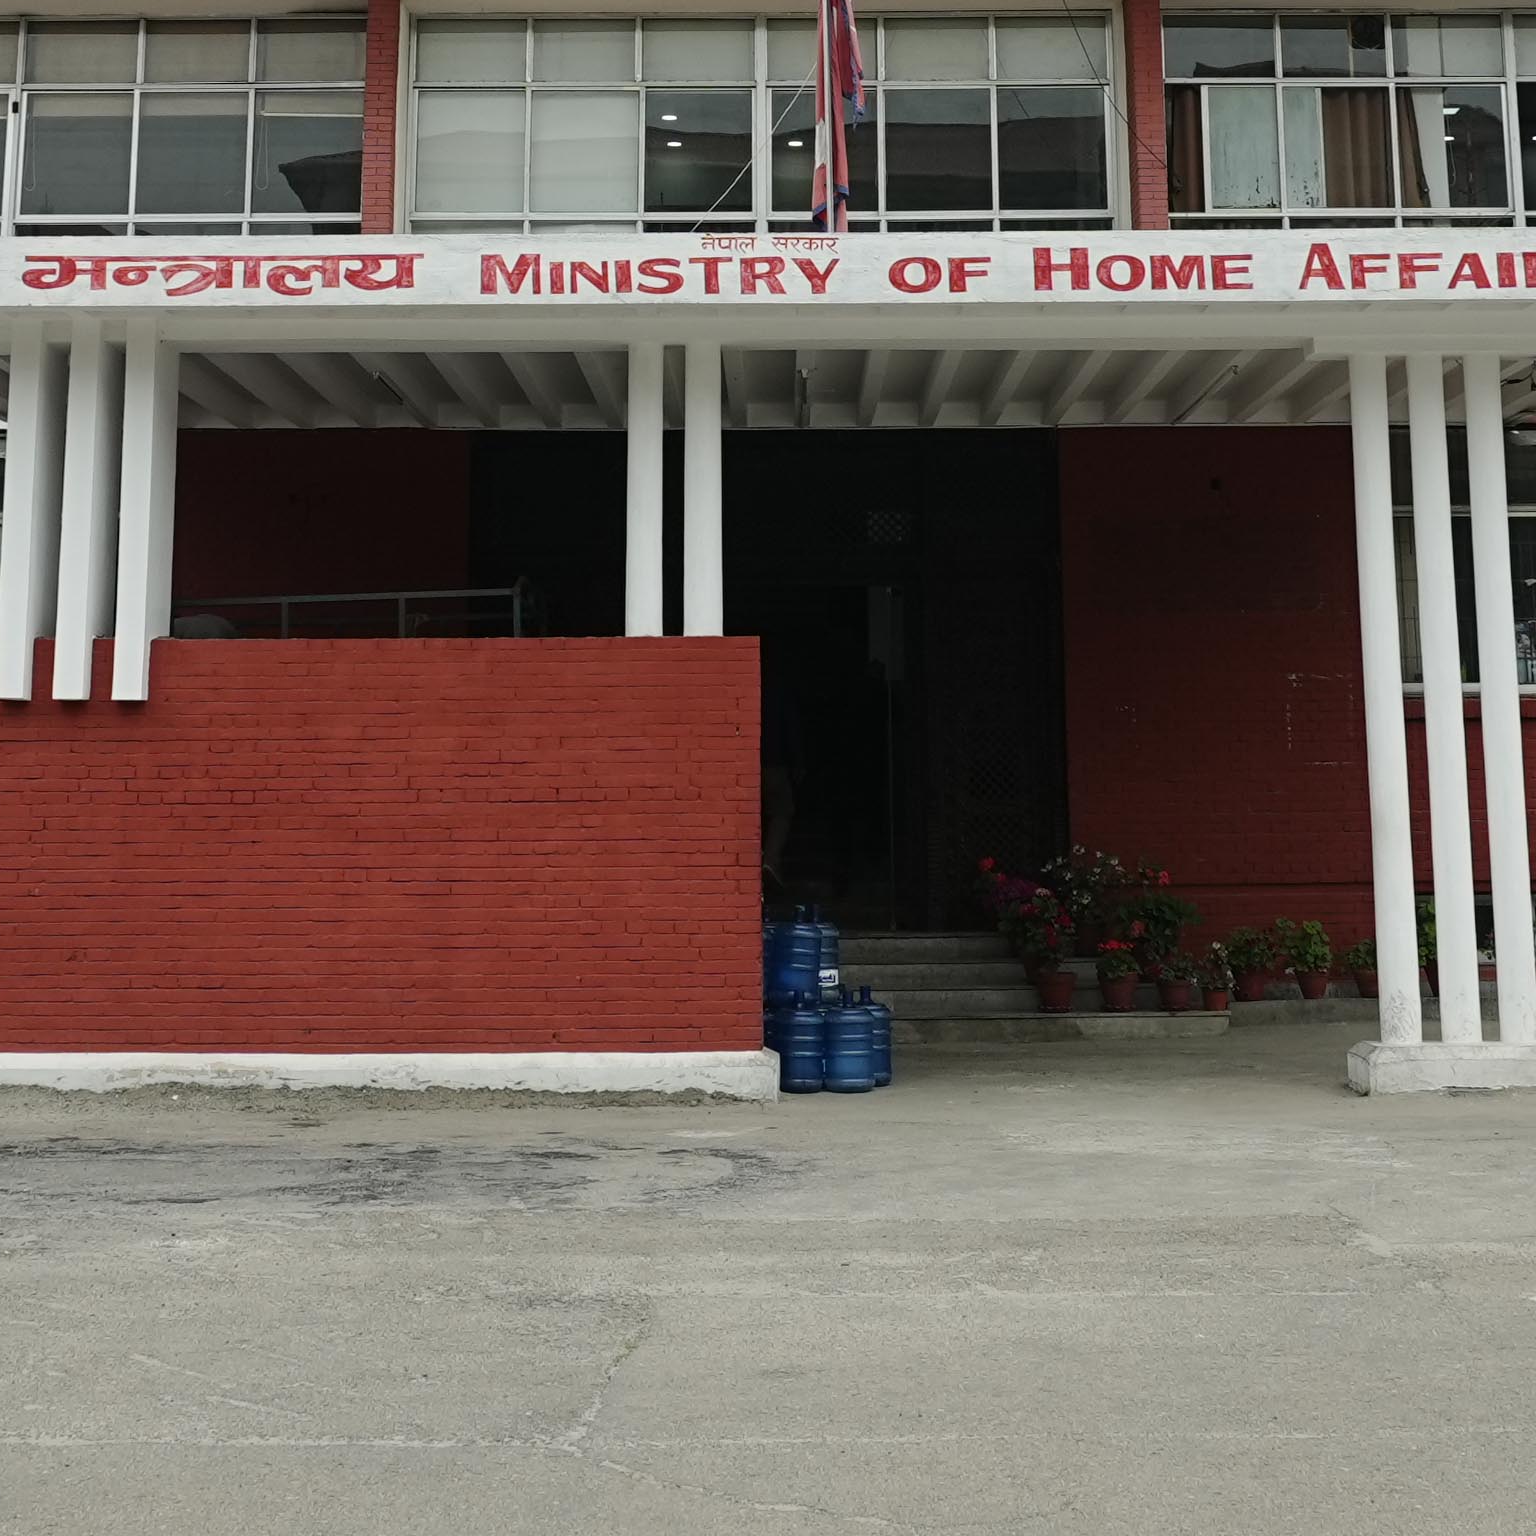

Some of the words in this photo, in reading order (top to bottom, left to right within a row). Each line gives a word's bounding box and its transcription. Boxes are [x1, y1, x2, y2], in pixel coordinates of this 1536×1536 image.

[700, 233, 758, 254] नेपाल
[771, 236, 840, 254] सरकार
[21, 252, 425, 298] मन्त्रालय
[479, 252, 841, 296] MINISTRY
[887, 256, 993, 294] OF
[1032, 246, 1255, 293] HOME
